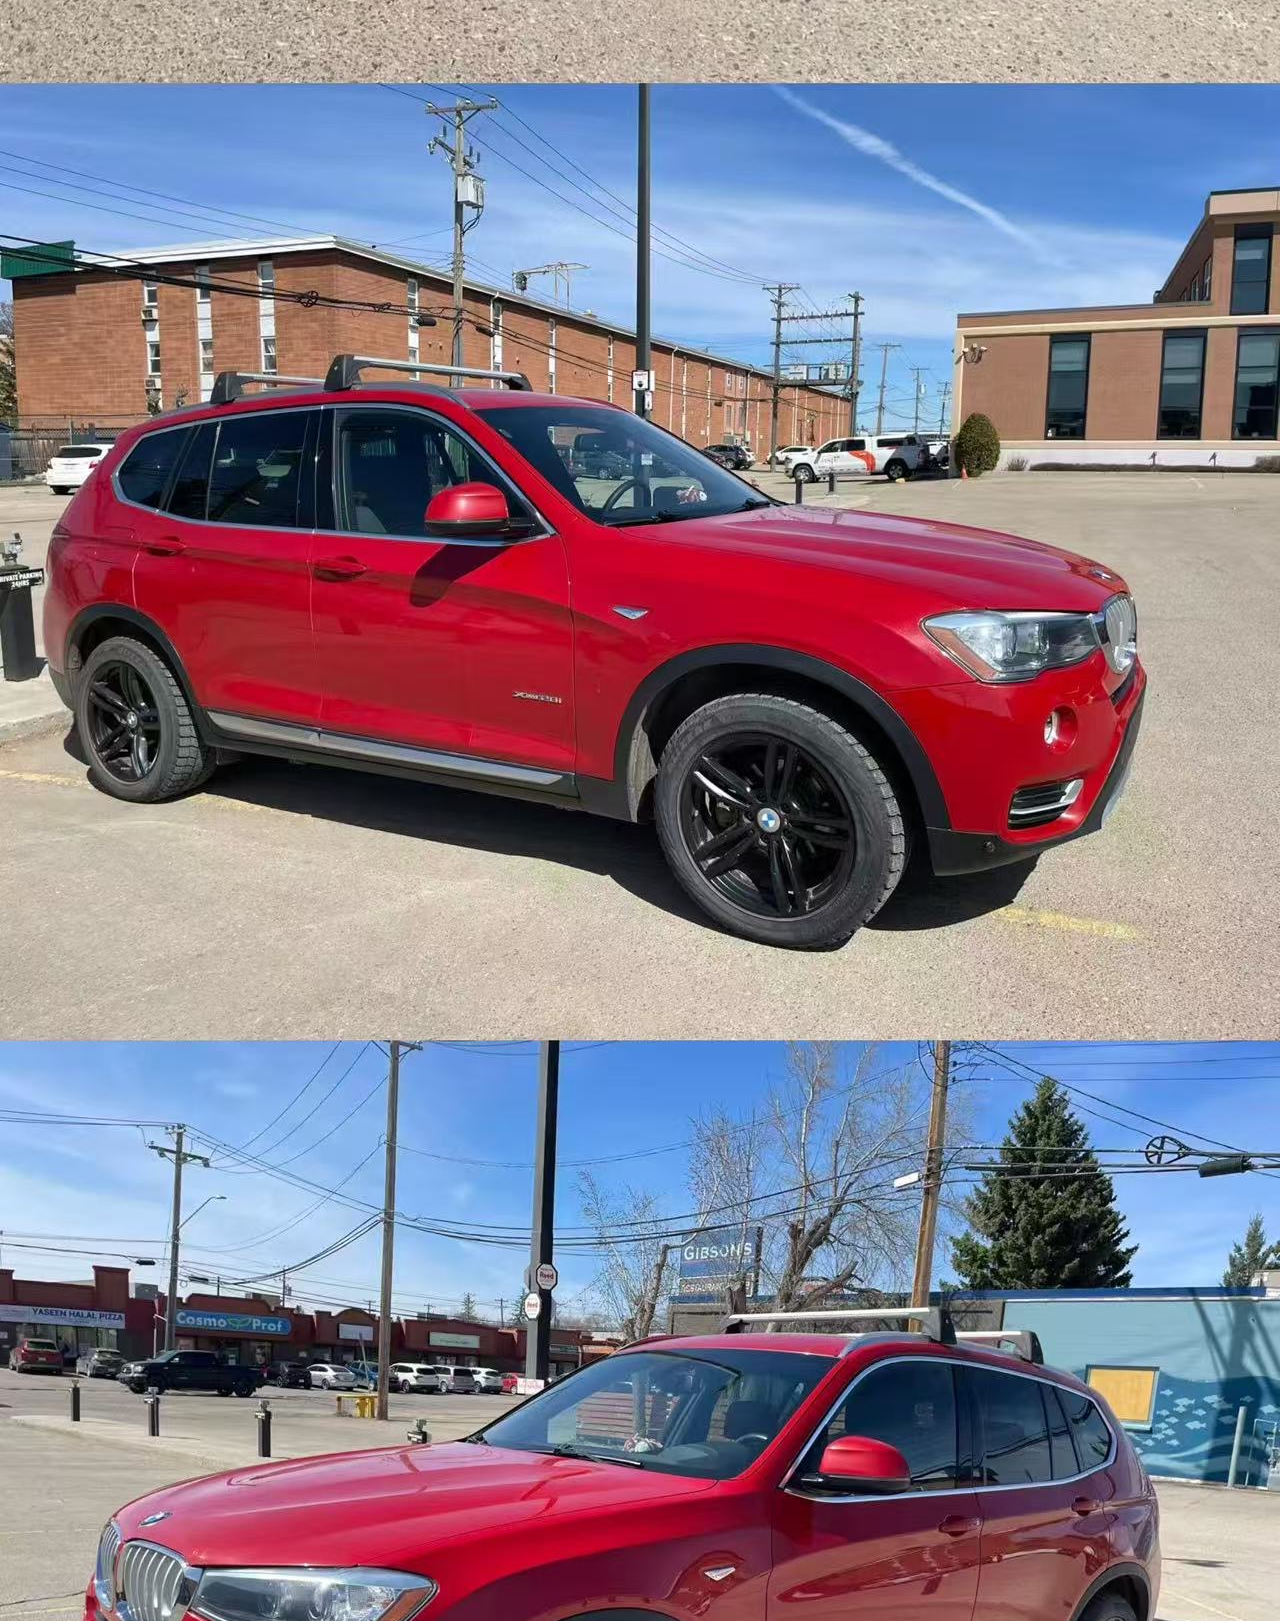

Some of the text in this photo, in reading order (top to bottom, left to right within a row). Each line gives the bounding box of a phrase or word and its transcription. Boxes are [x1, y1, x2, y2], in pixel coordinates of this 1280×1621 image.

[20, 570, 43, 580] PARKING
[684, 1242, 752, 1260] GIBSONS
[31, 1307, 67, 1318] YASEEN
[68, 1309, 97, 1320] HALAL
[99, 1312, 124, 1321] PIZZA
[176, 1311, 282, 1332] Cosmo Prof
